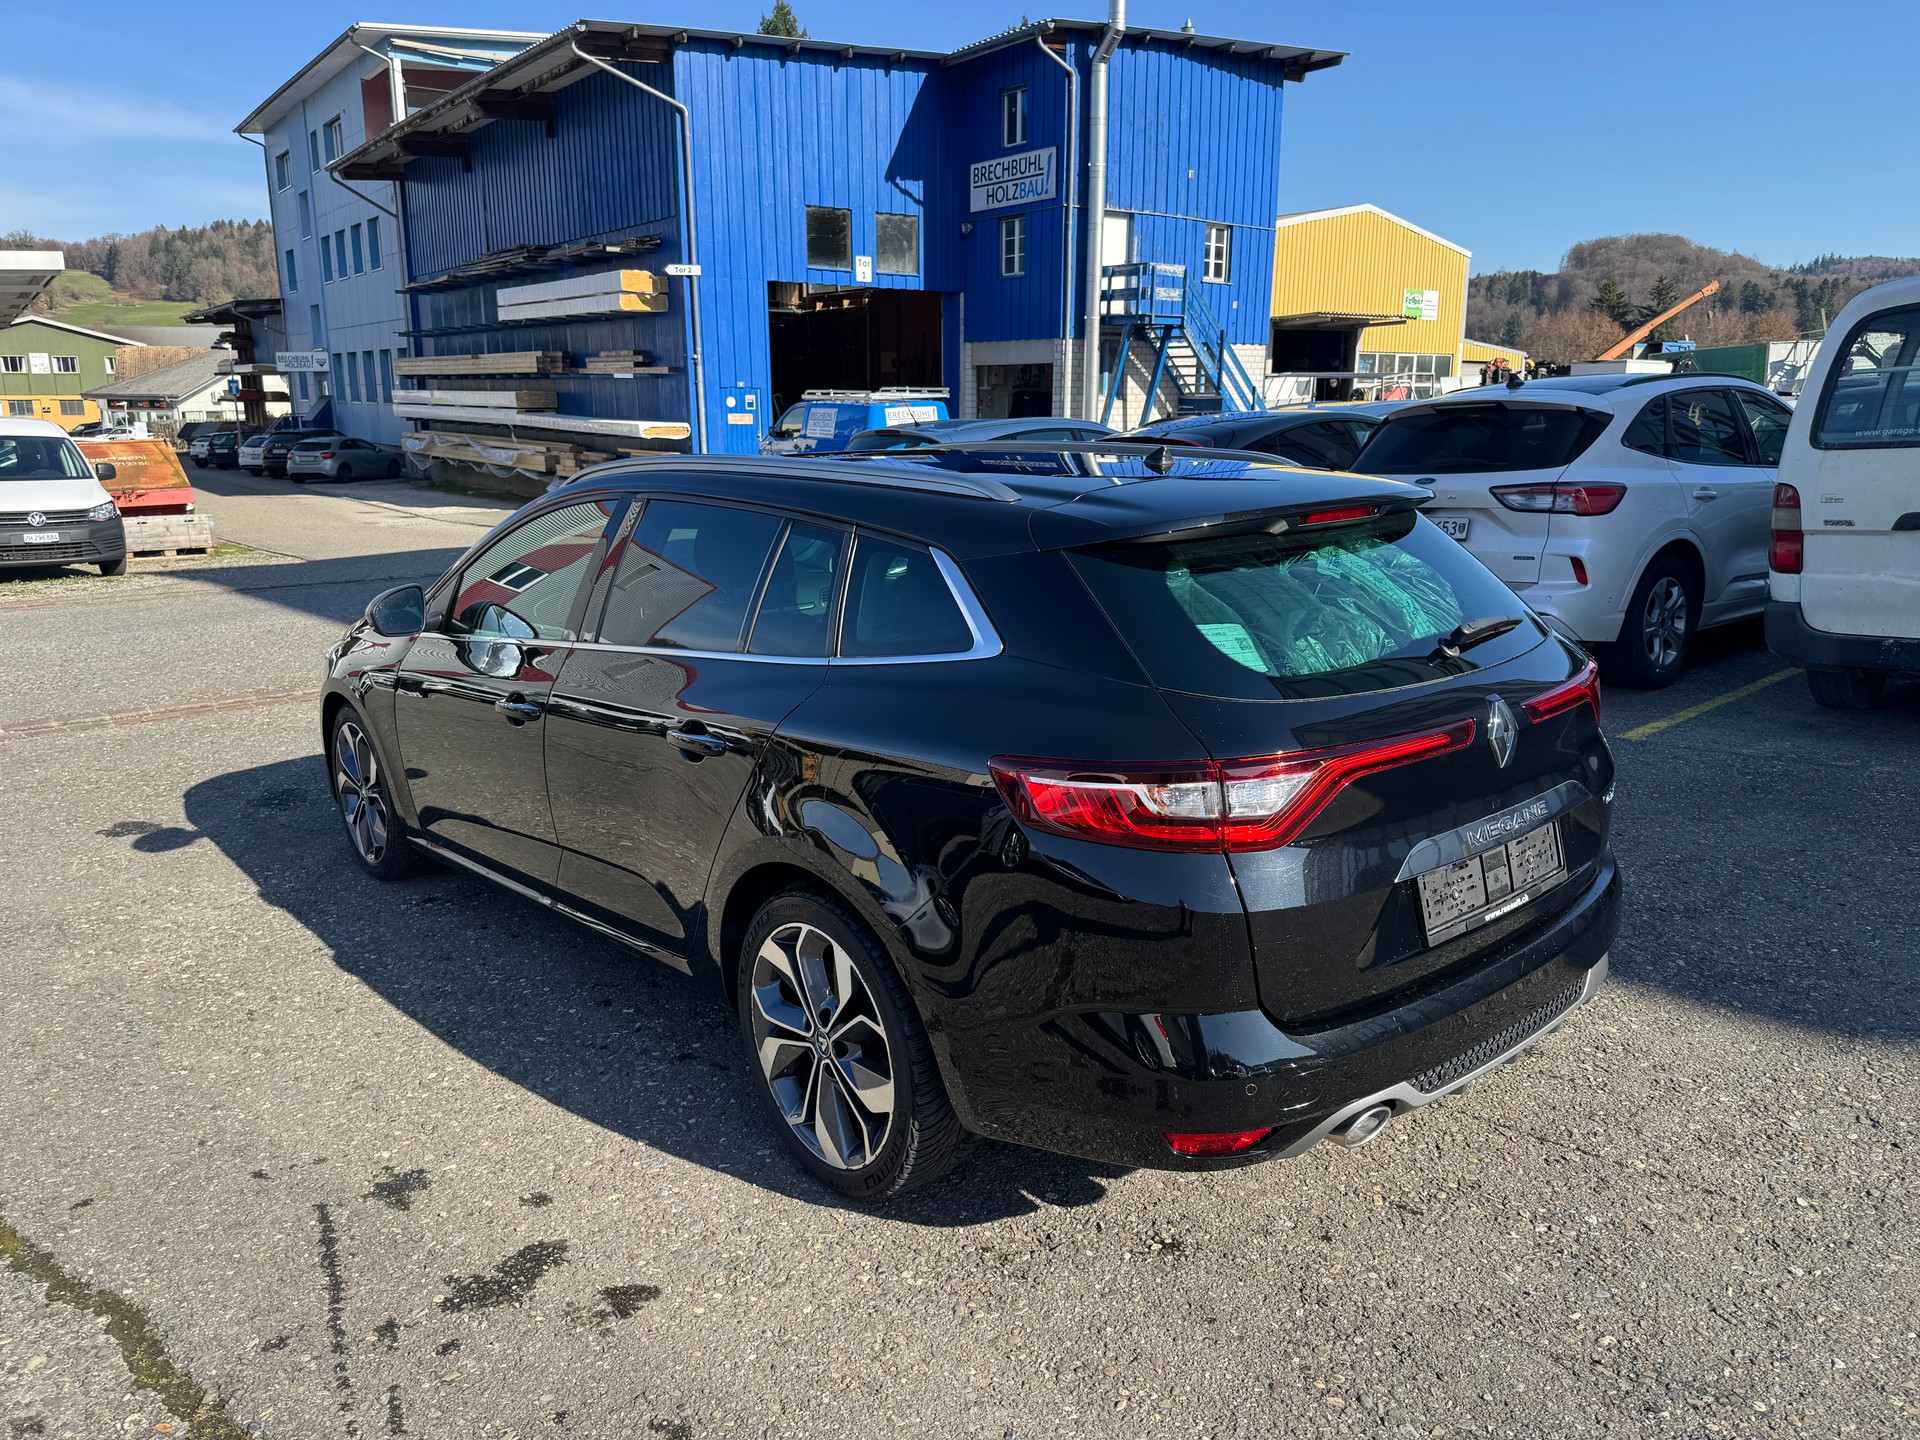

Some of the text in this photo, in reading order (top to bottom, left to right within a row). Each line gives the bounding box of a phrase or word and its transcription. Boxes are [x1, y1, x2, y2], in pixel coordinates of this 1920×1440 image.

[973, 154, 1044, 184] BRECHBÜHL
[858, 259, 870, 267] Tor
[1855, 427, 1920, 437] www.garage-
[1823, 519, 1855, 527] TOYOTA
[1466, 800, 1549, 848] MEGANE
